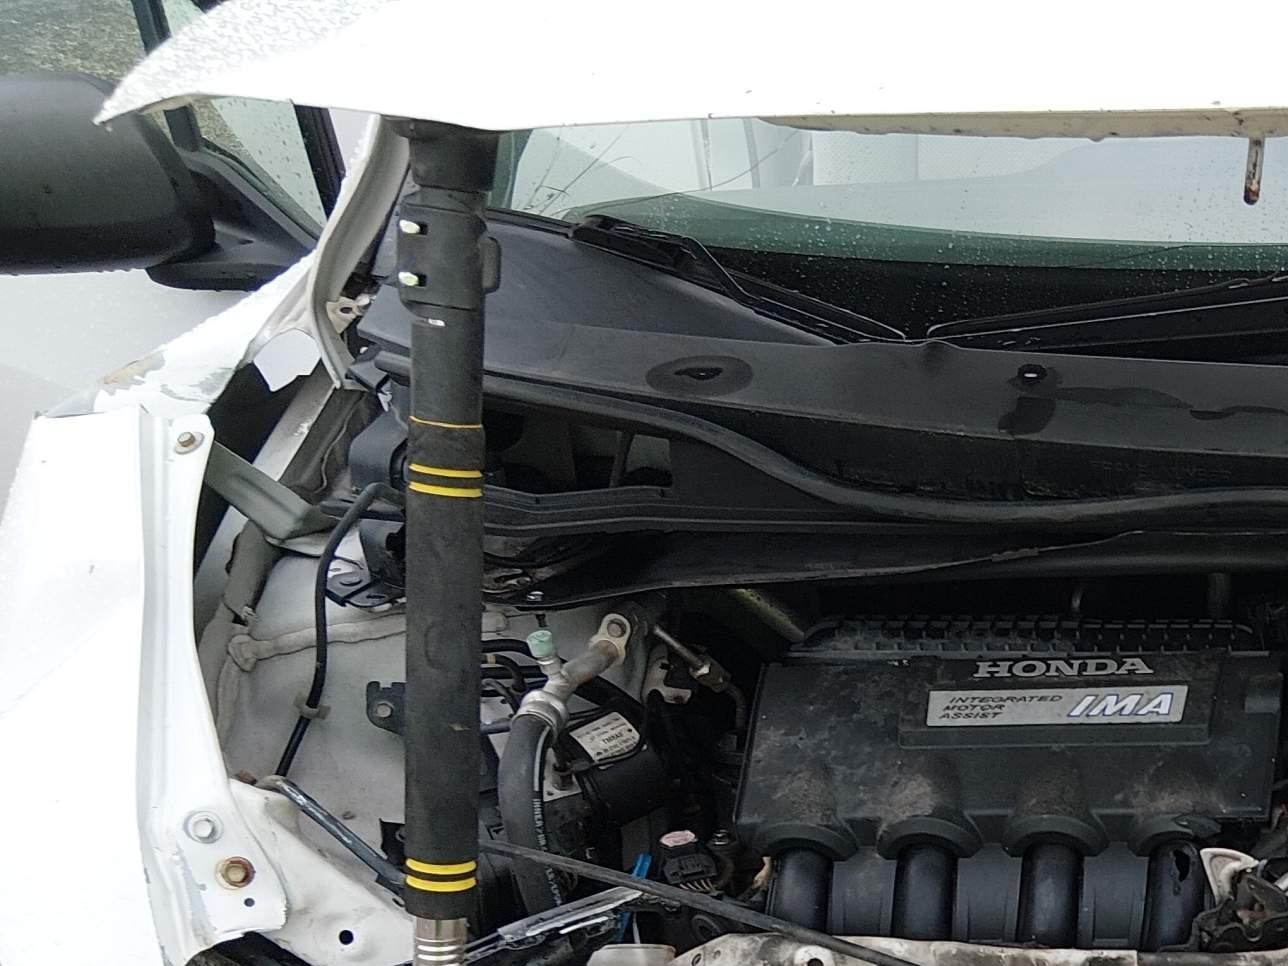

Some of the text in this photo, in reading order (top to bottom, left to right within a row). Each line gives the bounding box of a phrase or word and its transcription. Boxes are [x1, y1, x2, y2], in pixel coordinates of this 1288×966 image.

[973, 657, 1155, 677] HONDA
[949, 694, 1063, 703] INTEGRATED
[1066, 692, 1175, 717] IMA
